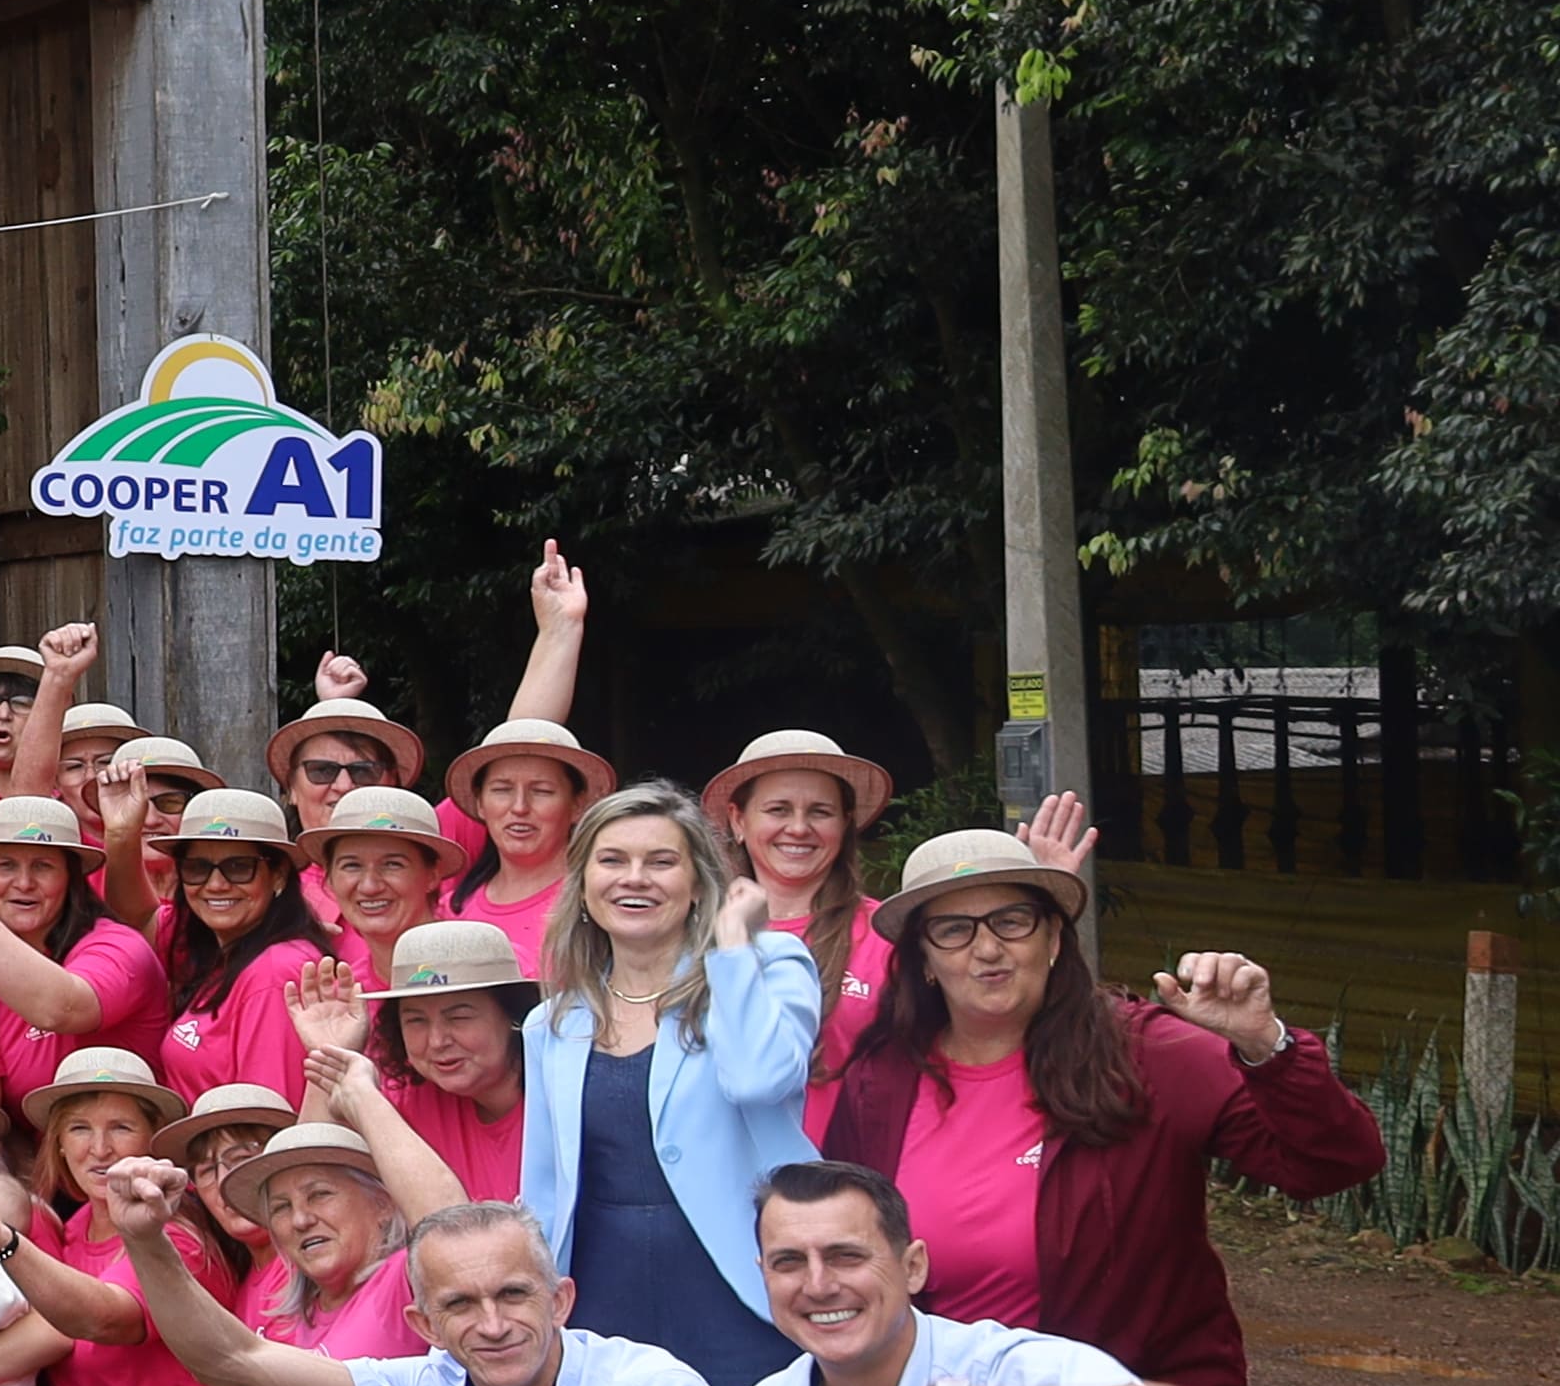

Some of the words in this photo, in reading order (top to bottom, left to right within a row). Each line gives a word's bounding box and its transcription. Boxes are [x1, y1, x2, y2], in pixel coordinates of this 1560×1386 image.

[39, 472, 229, 513] COOPER
[245, 436, 374, 520] A1
[117, 519, 162, 550] faz
[167, 524, 244, 553] parte
[252, 525, 287, 551] da
[296, 529, 375, 559] gente
[431, 974, 448, 985] A1
